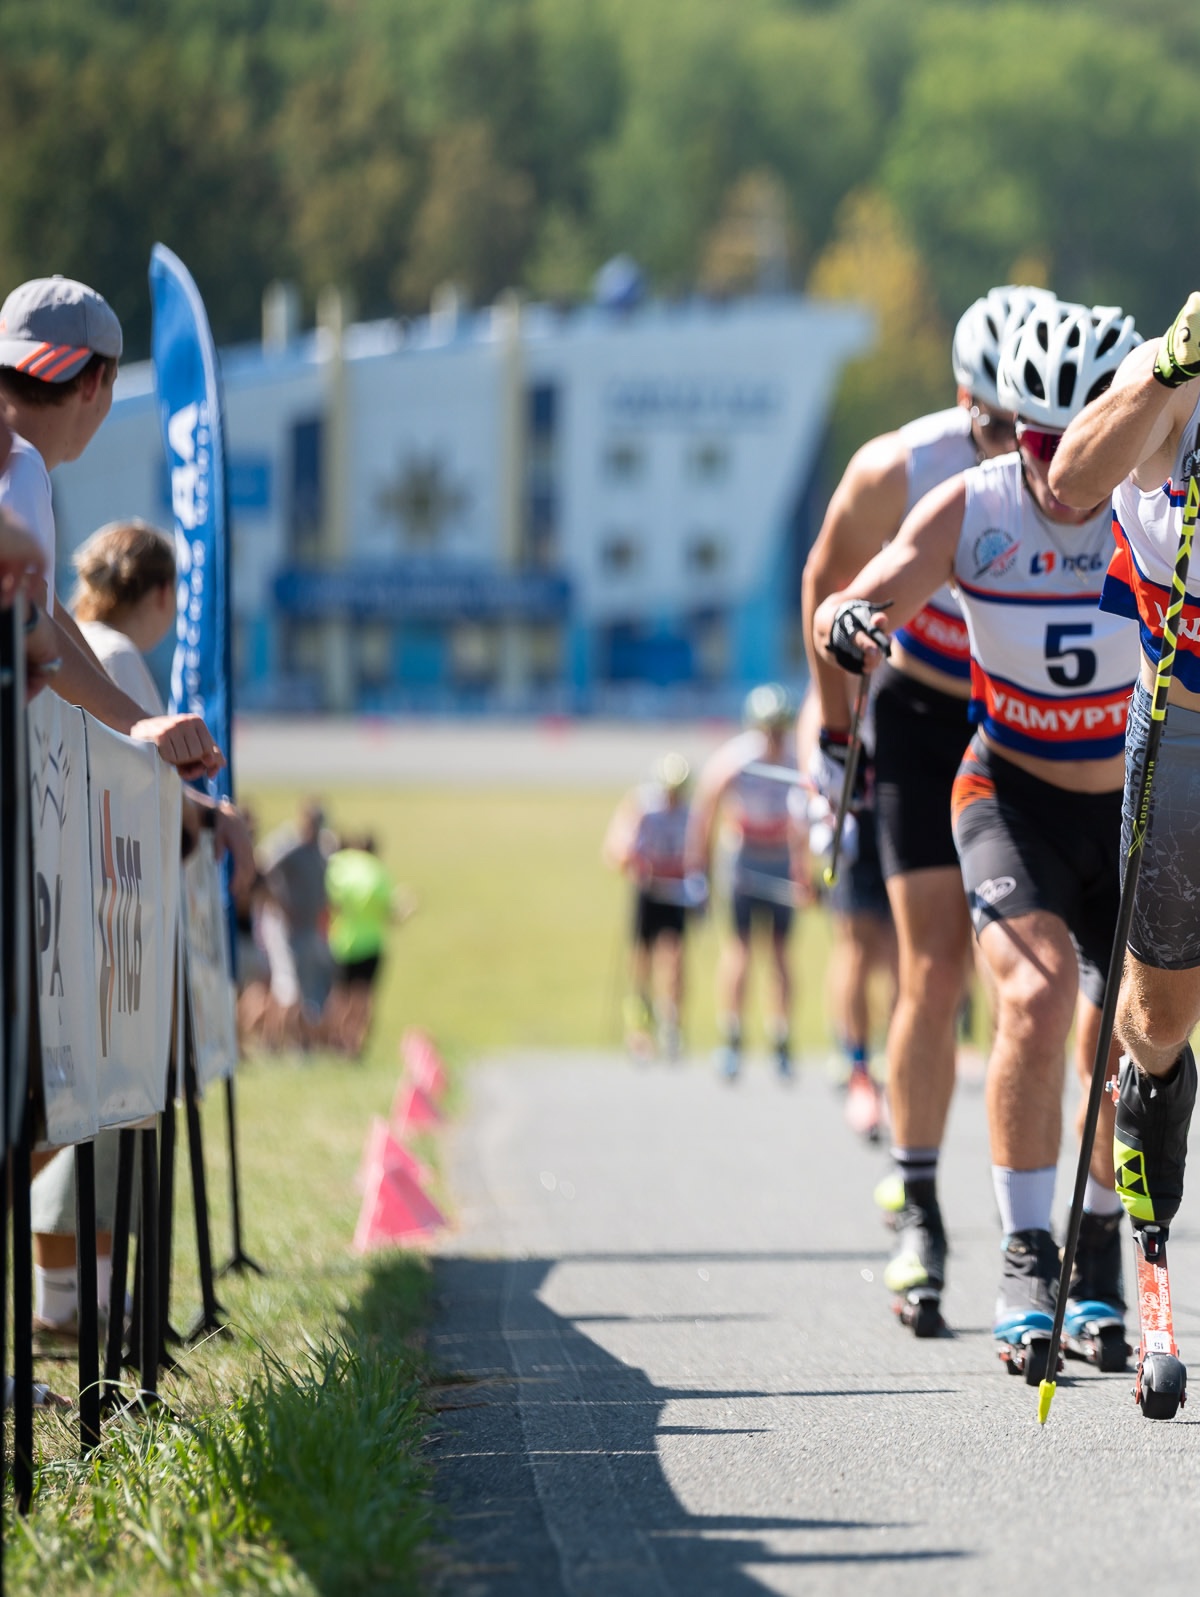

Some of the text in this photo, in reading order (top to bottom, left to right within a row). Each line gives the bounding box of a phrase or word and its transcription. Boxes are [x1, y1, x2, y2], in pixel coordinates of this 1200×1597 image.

[1062, 553, 1103, 571] ПСБ
[1044, 623, 1097, 688] 5
[991, 688, 1128, 732] УДМУРТ
[1139, 761, 1155, 825] BLACKCODE
[116, 835, 142, 1016] ПСБ
[1157, 1267, 1169, 1312] SPEEDPOWER
